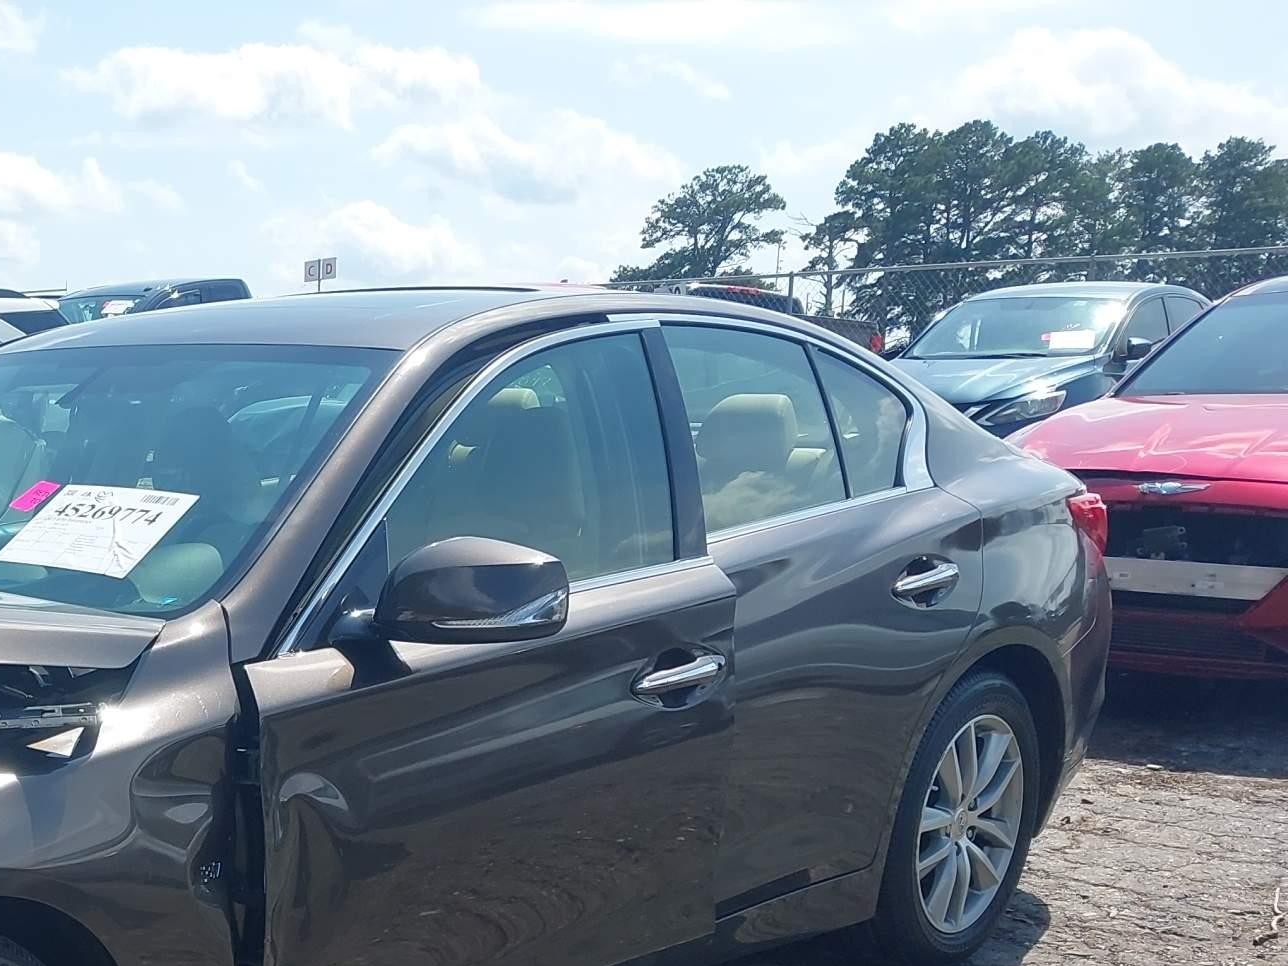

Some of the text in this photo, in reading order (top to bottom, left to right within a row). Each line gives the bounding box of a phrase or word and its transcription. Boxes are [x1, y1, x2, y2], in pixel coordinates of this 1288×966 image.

[308, 263, 333, 277] C D
[54, 502, 163, 526] 45269774
